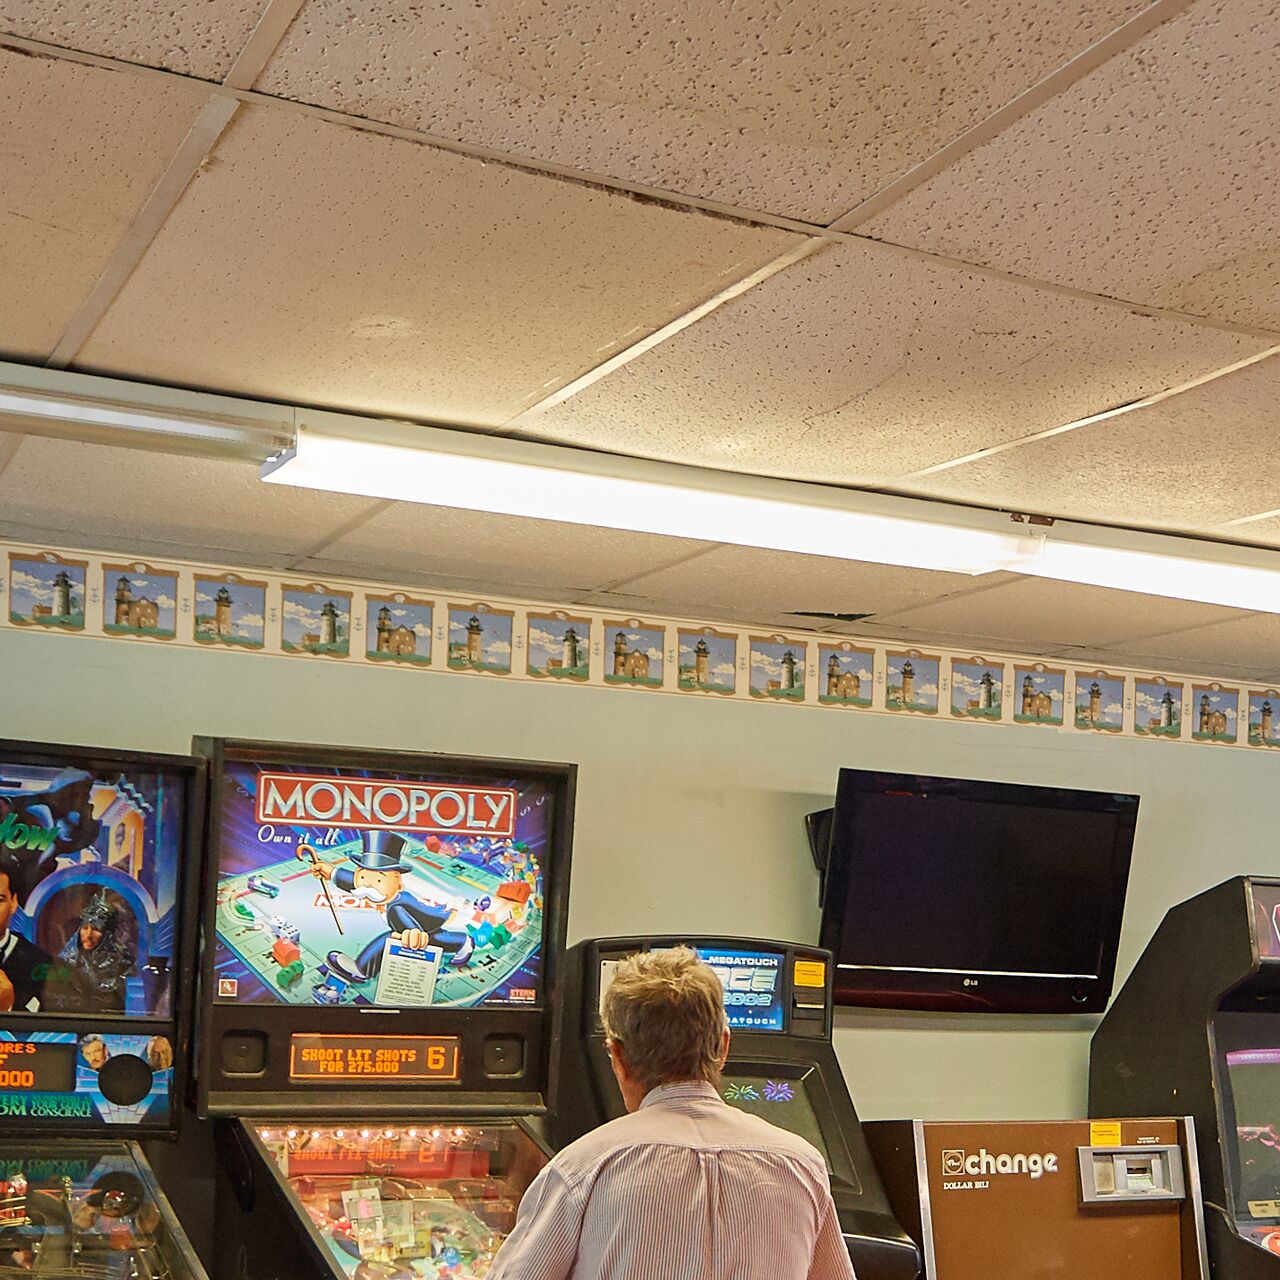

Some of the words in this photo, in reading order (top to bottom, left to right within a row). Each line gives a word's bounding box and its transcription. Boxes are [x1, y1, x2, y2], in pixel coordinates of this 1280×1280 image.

[264, 780, 510, 829] MONOPOLY
[257, 824, 292, 844] Own
[298, 833, 310, 845] it
[315, 828, 337, 846] all
[708, 956, 778, 967] MEGATOUCH
[301, 1048, 343, 1061] SHOOT
[348, 1049, 372, 1061] LIT
[376, 1050, 417, 1062] SHOTS
[427, 1046, 446, 1070] 6
[320, 1061, 344, 1073] FOR
[30, 1108, 92, 1118] CONSCIENCE
[965, 1148, 1058, 1179] change
[943, 1182, 973, 1190] DOLLAR
